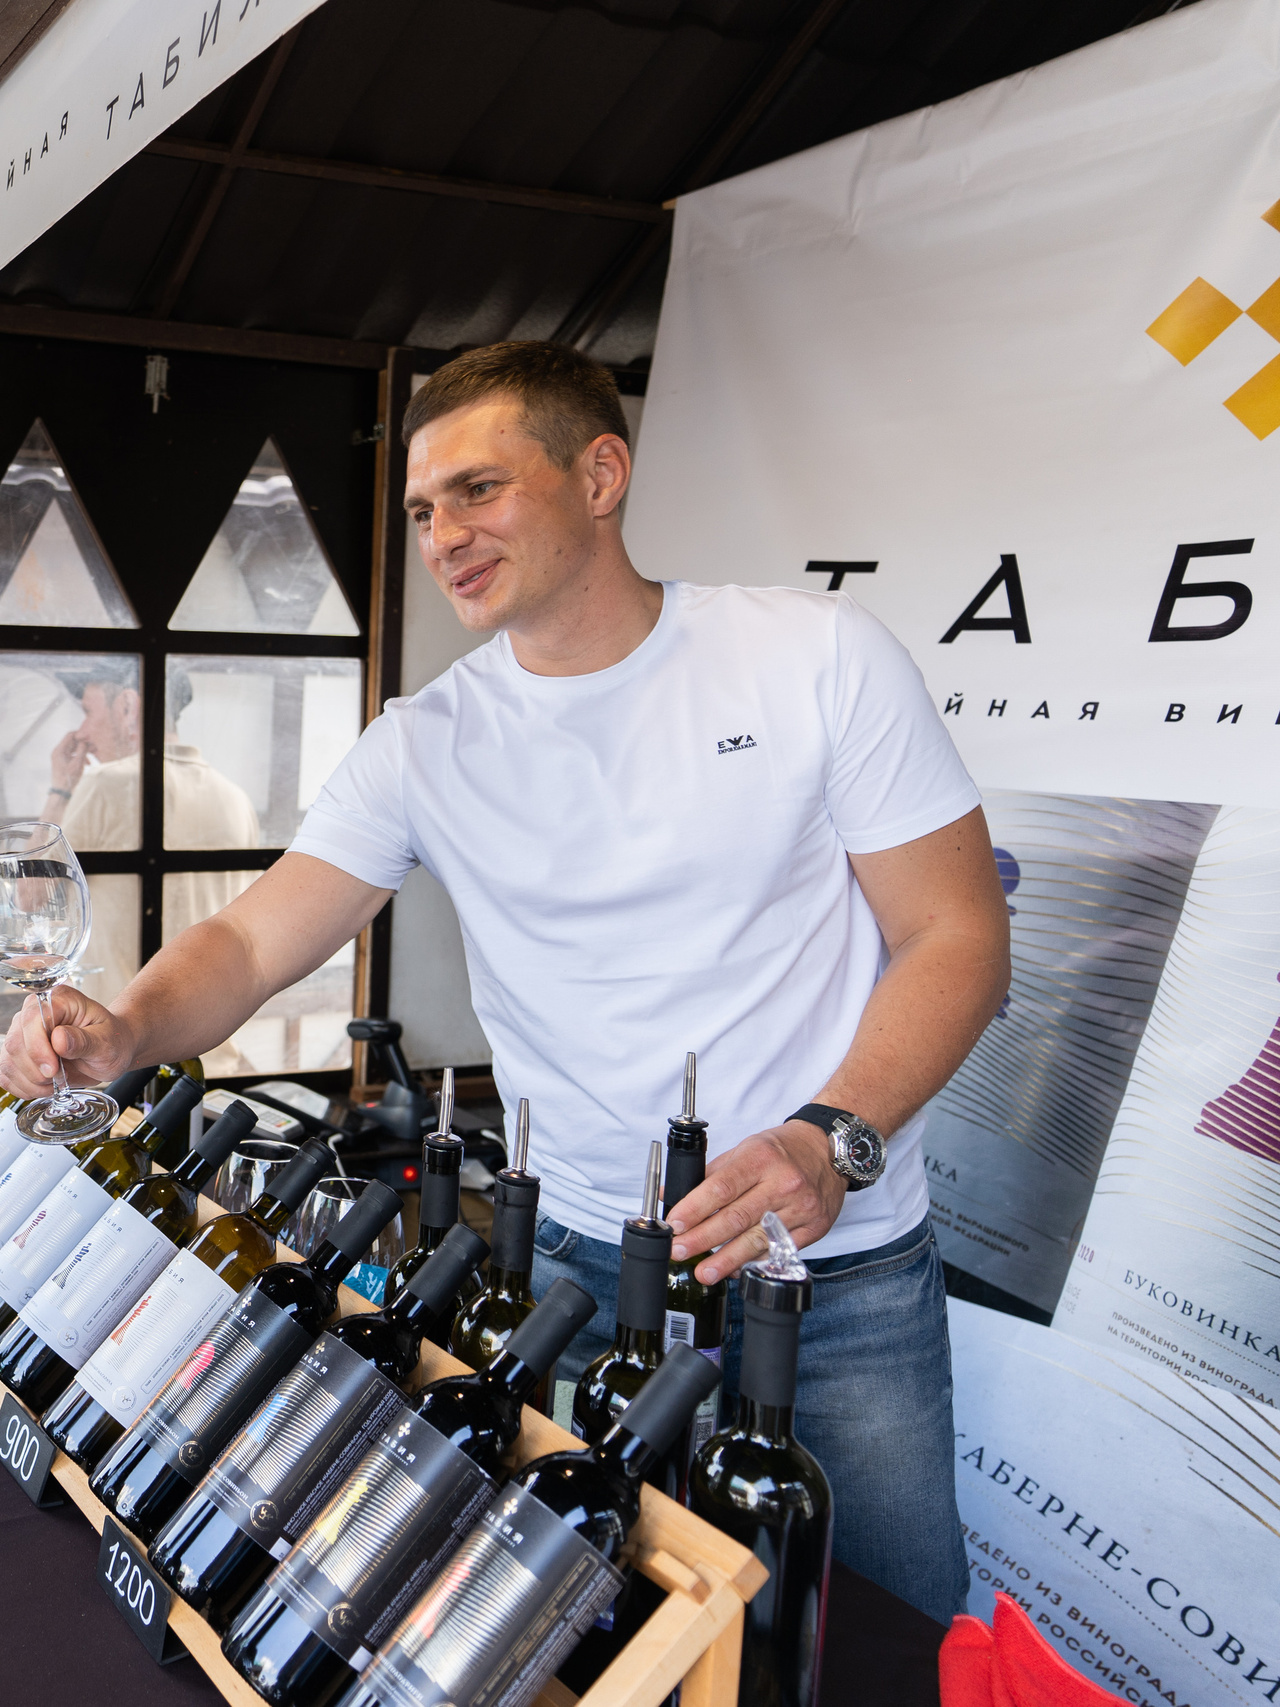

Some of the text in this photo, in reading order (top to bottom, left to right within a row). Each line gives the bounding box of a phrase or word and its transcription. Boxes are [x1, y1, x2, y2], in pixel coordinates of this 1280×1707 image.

[1107, 1325, 1119, 1336] НА
[1120, 1332, 1182, 1373] ТЕРРИТОРИИ
[1112, 1311, 1179, 1353] ПРОИЗВЕДЕНО
[1181, 1350, 1196, 1363] ИЗ
[1123, 1269, 1280, 1363] БУКОВИНКА
[0, 1414, 40, 1481] 900
[282, 1516, 298, 1532] ВИНО
[292, 1500, 309, 1518] СУХОЕ
[304, 1479, 325, 1503] КРАСНОЕ
[359, 1418, 372, 1430] ГОД
[366, 1401, 384, 1421] УРОЖАЯ
[378, 1387, 394, 1404] 2020
[379, 1431, 417, 1464] ТАБИЯ
[105, 1541, 155, 1626] 1200
[955, 1433, 1280, 1704] АБЕРНЕ-СОВИ
[1035, 1581, 1063, 1606] ИЗ
